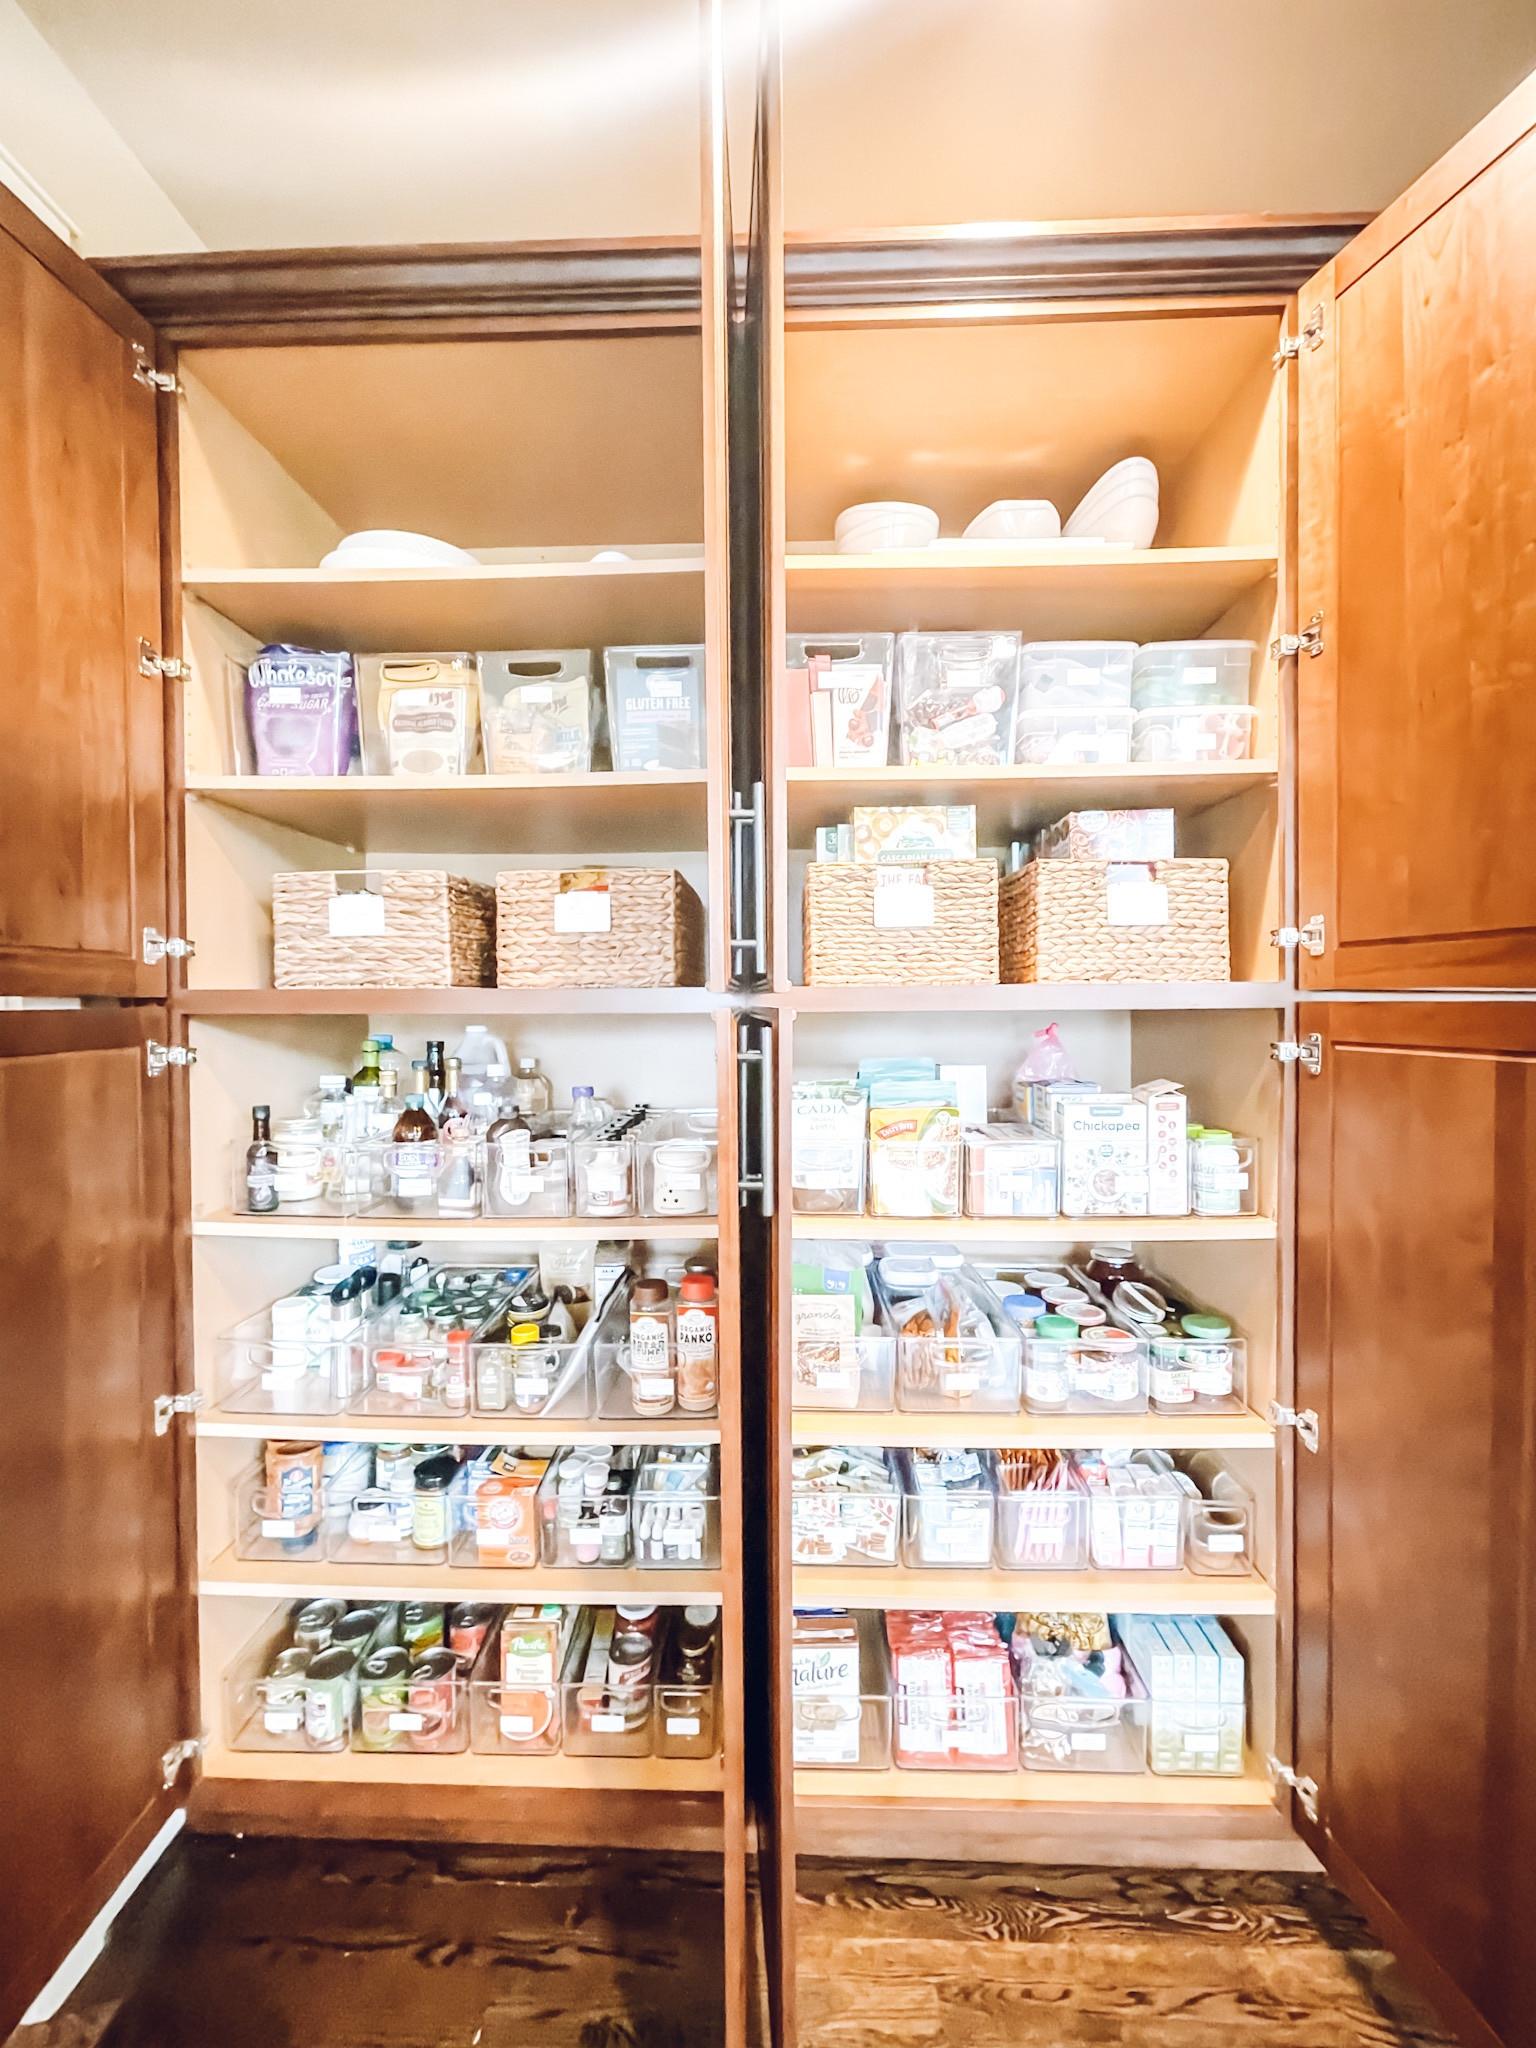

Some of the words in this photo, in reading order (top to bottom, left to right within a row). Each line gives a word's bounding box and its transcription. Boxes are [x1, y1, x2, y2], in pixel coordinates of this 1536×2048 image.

[625, 697, 664, 711] GLUTEN
[666, 696, 691, 709] FREE
[797, 1104, 849, 1115] CADIA
[1073, 1119, 1141, 1132] Chickapea
[795, 1308, 841, 1325] granola
[680, 1323, 713, 1333] ORGANIC
[632, 1332, 665, 1341] ORGANIC
[680, 1332, 713, 1344] PANKO
